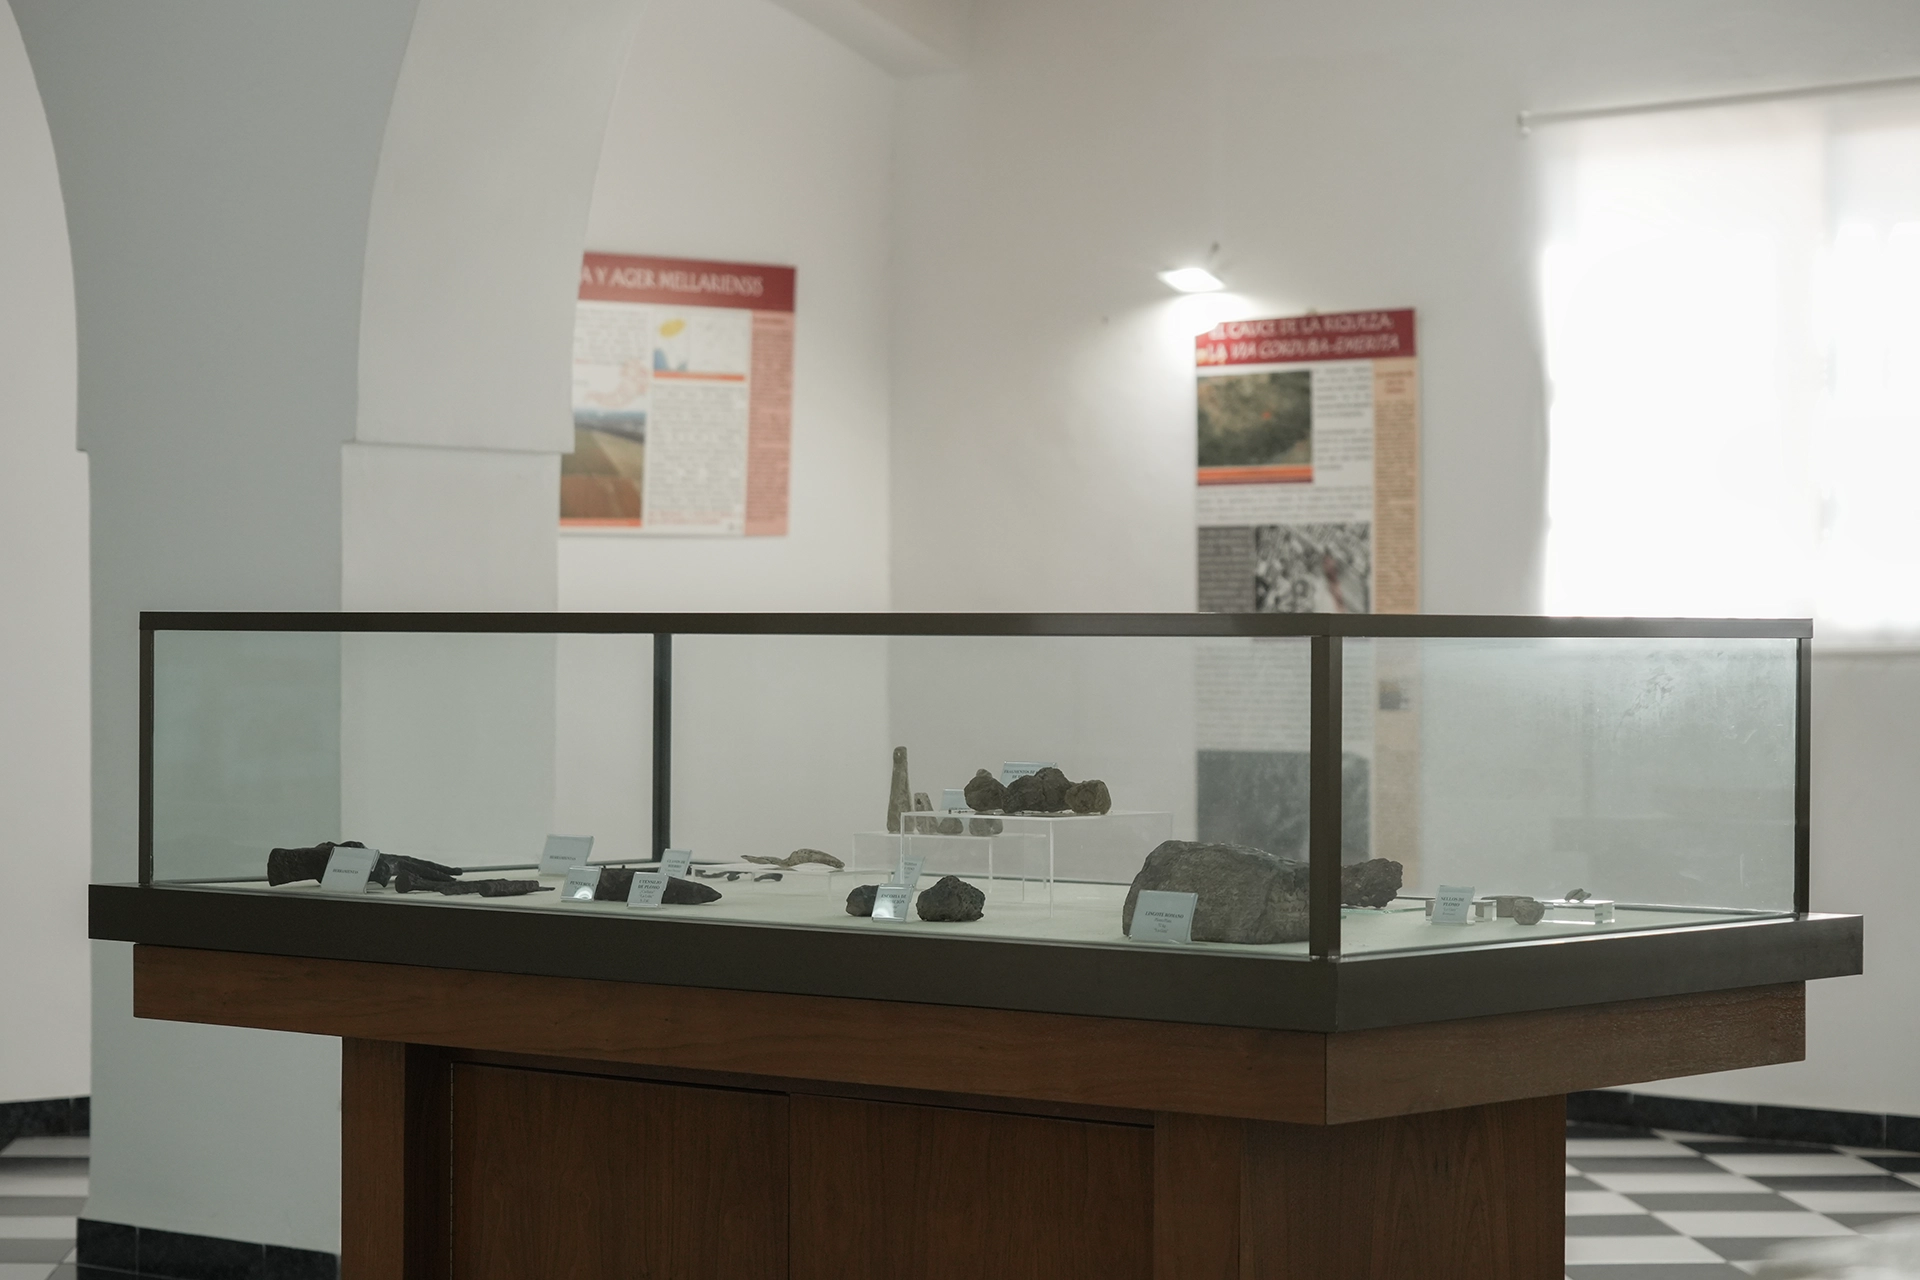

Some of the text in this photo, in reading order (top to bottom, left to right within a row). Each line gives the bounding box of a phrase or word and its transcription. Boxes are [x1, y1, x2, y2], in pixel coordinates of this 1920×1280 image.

[596, 266, 608, 286] Y
[608, 267, 657, 290] AGER
[1301, 316, 1322, 336] LA
